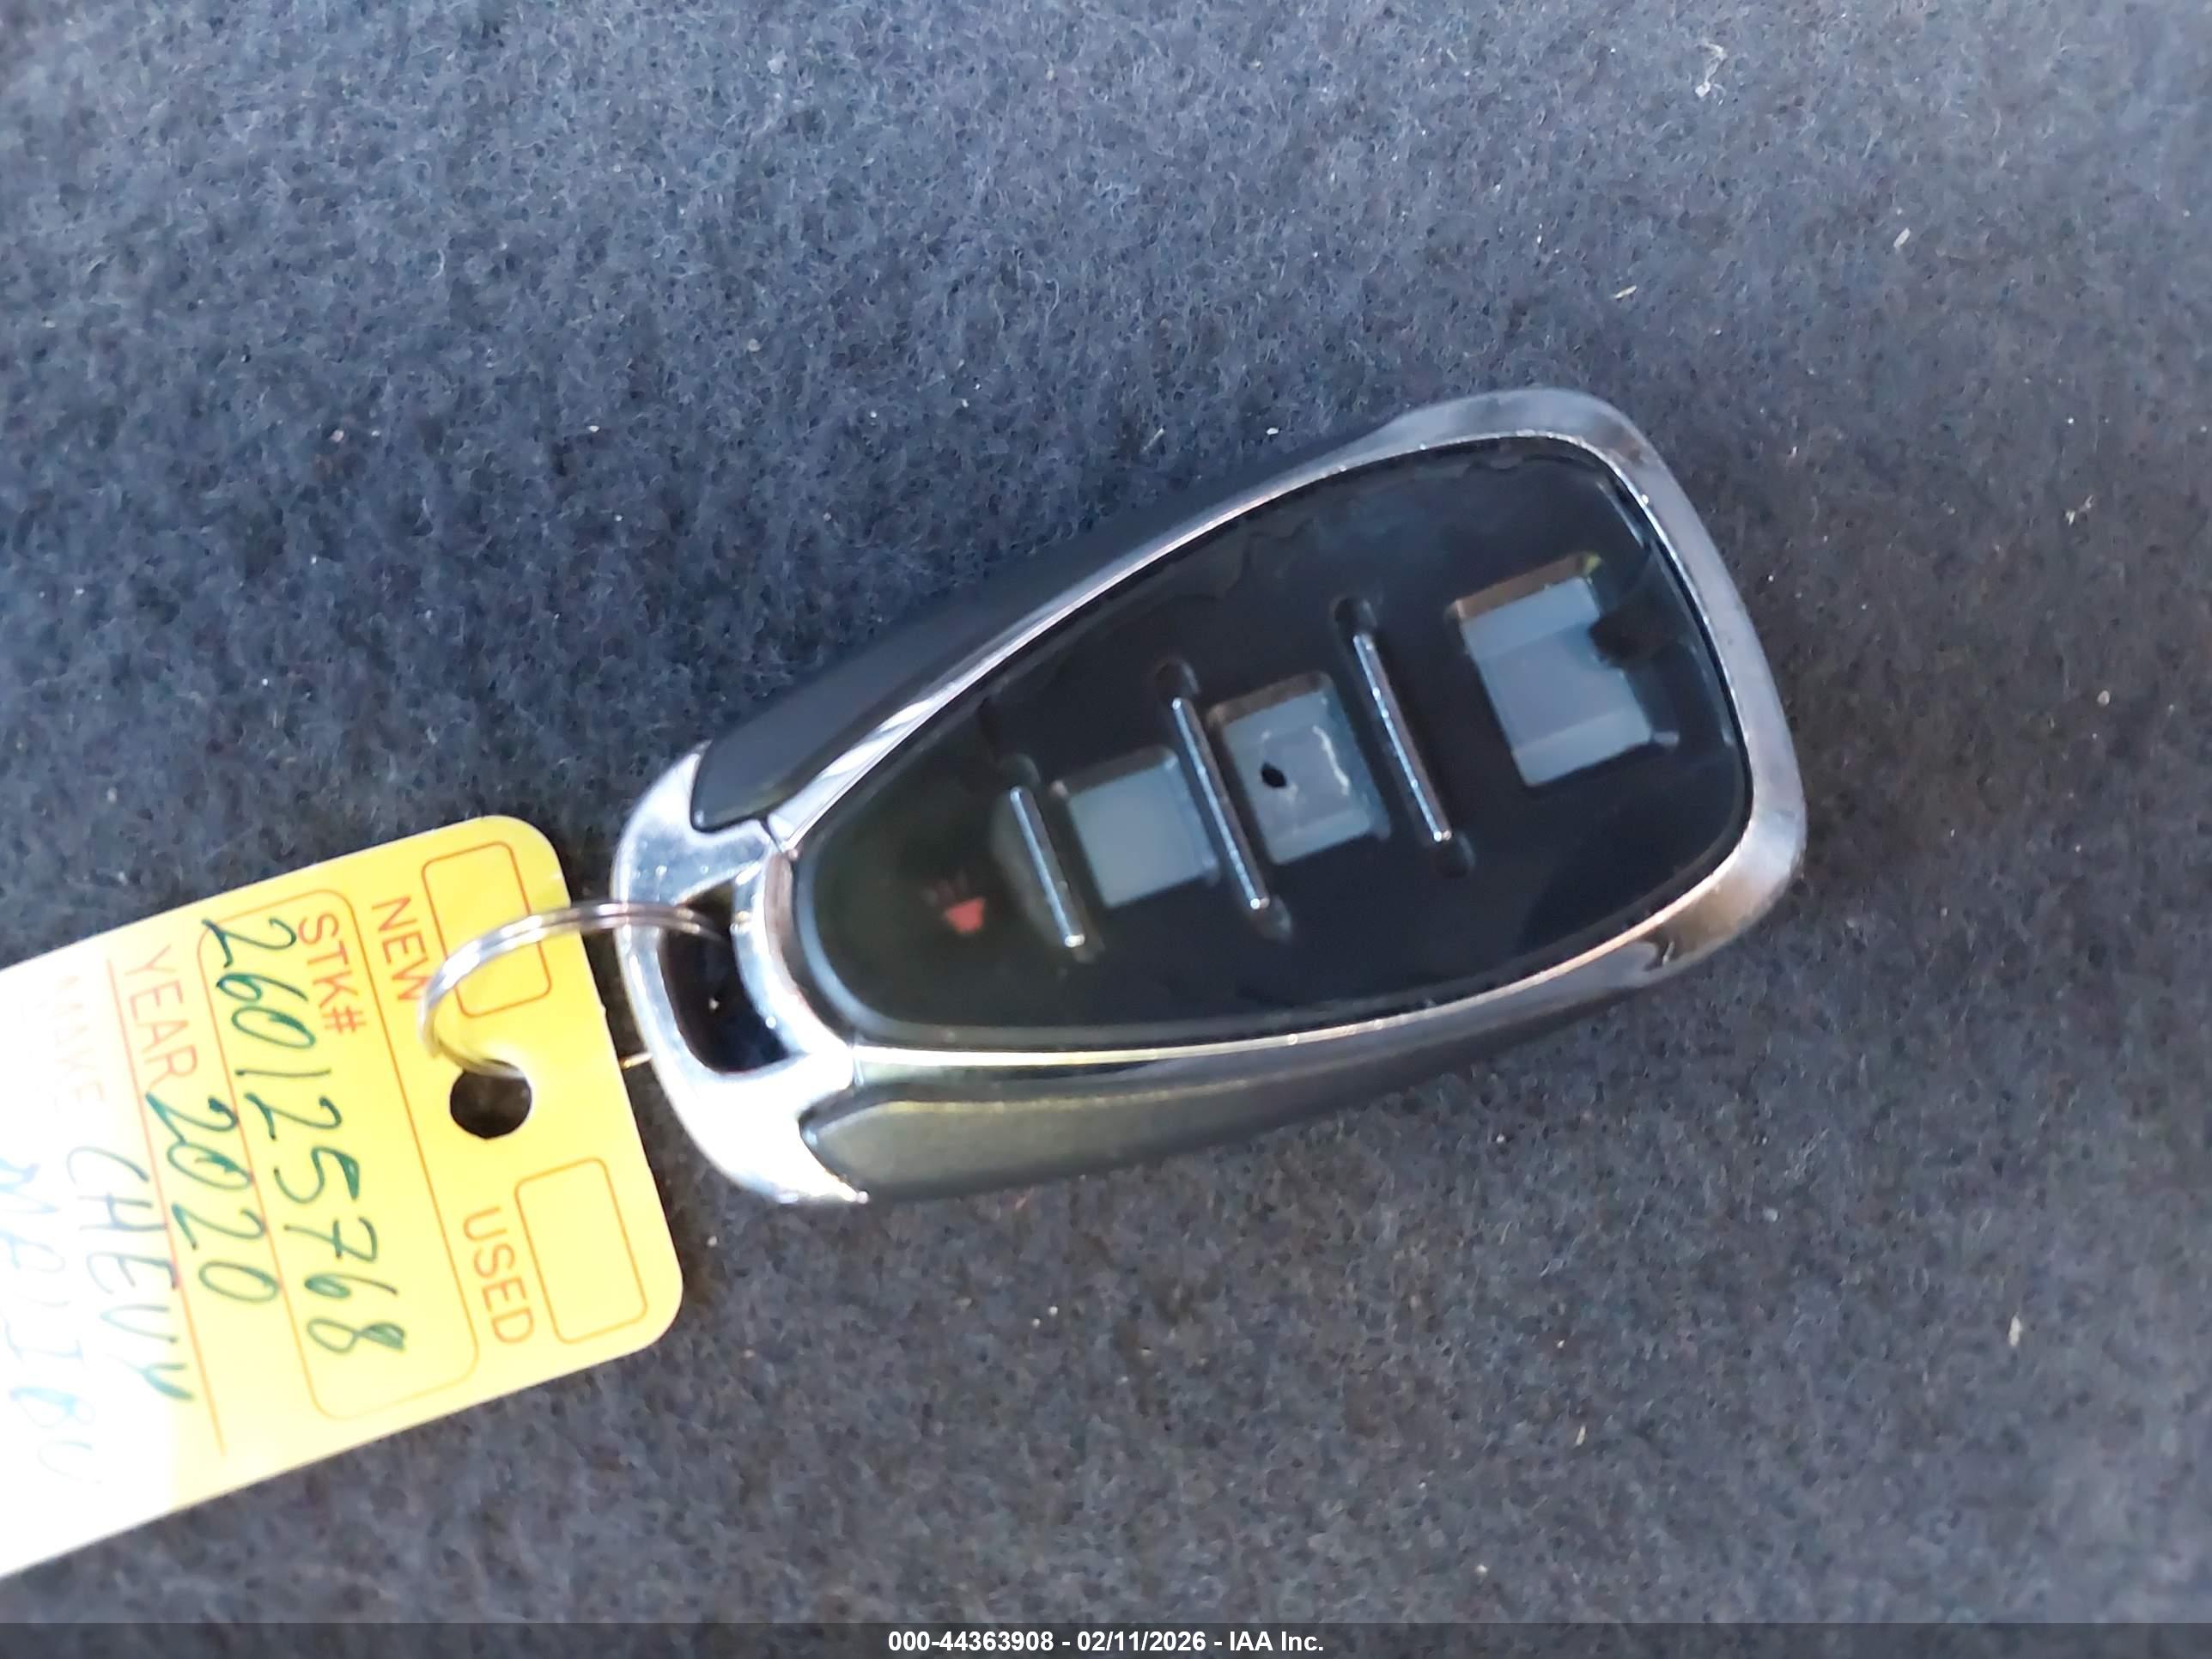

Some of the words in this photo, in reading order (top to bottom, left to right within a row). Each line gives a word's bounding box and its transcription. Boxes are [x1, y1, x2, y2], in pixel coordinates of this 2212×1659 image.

[125, 944, 198, 1085] YEAR
[299, 910, 367, 1036] STK#
[372, 894, 433, 1003] NEW
[146, 1091, 283, 1304] 2020
[66, 1145, 195, 1402] CHEVY
[463, 1206, 536, 1345] USED
